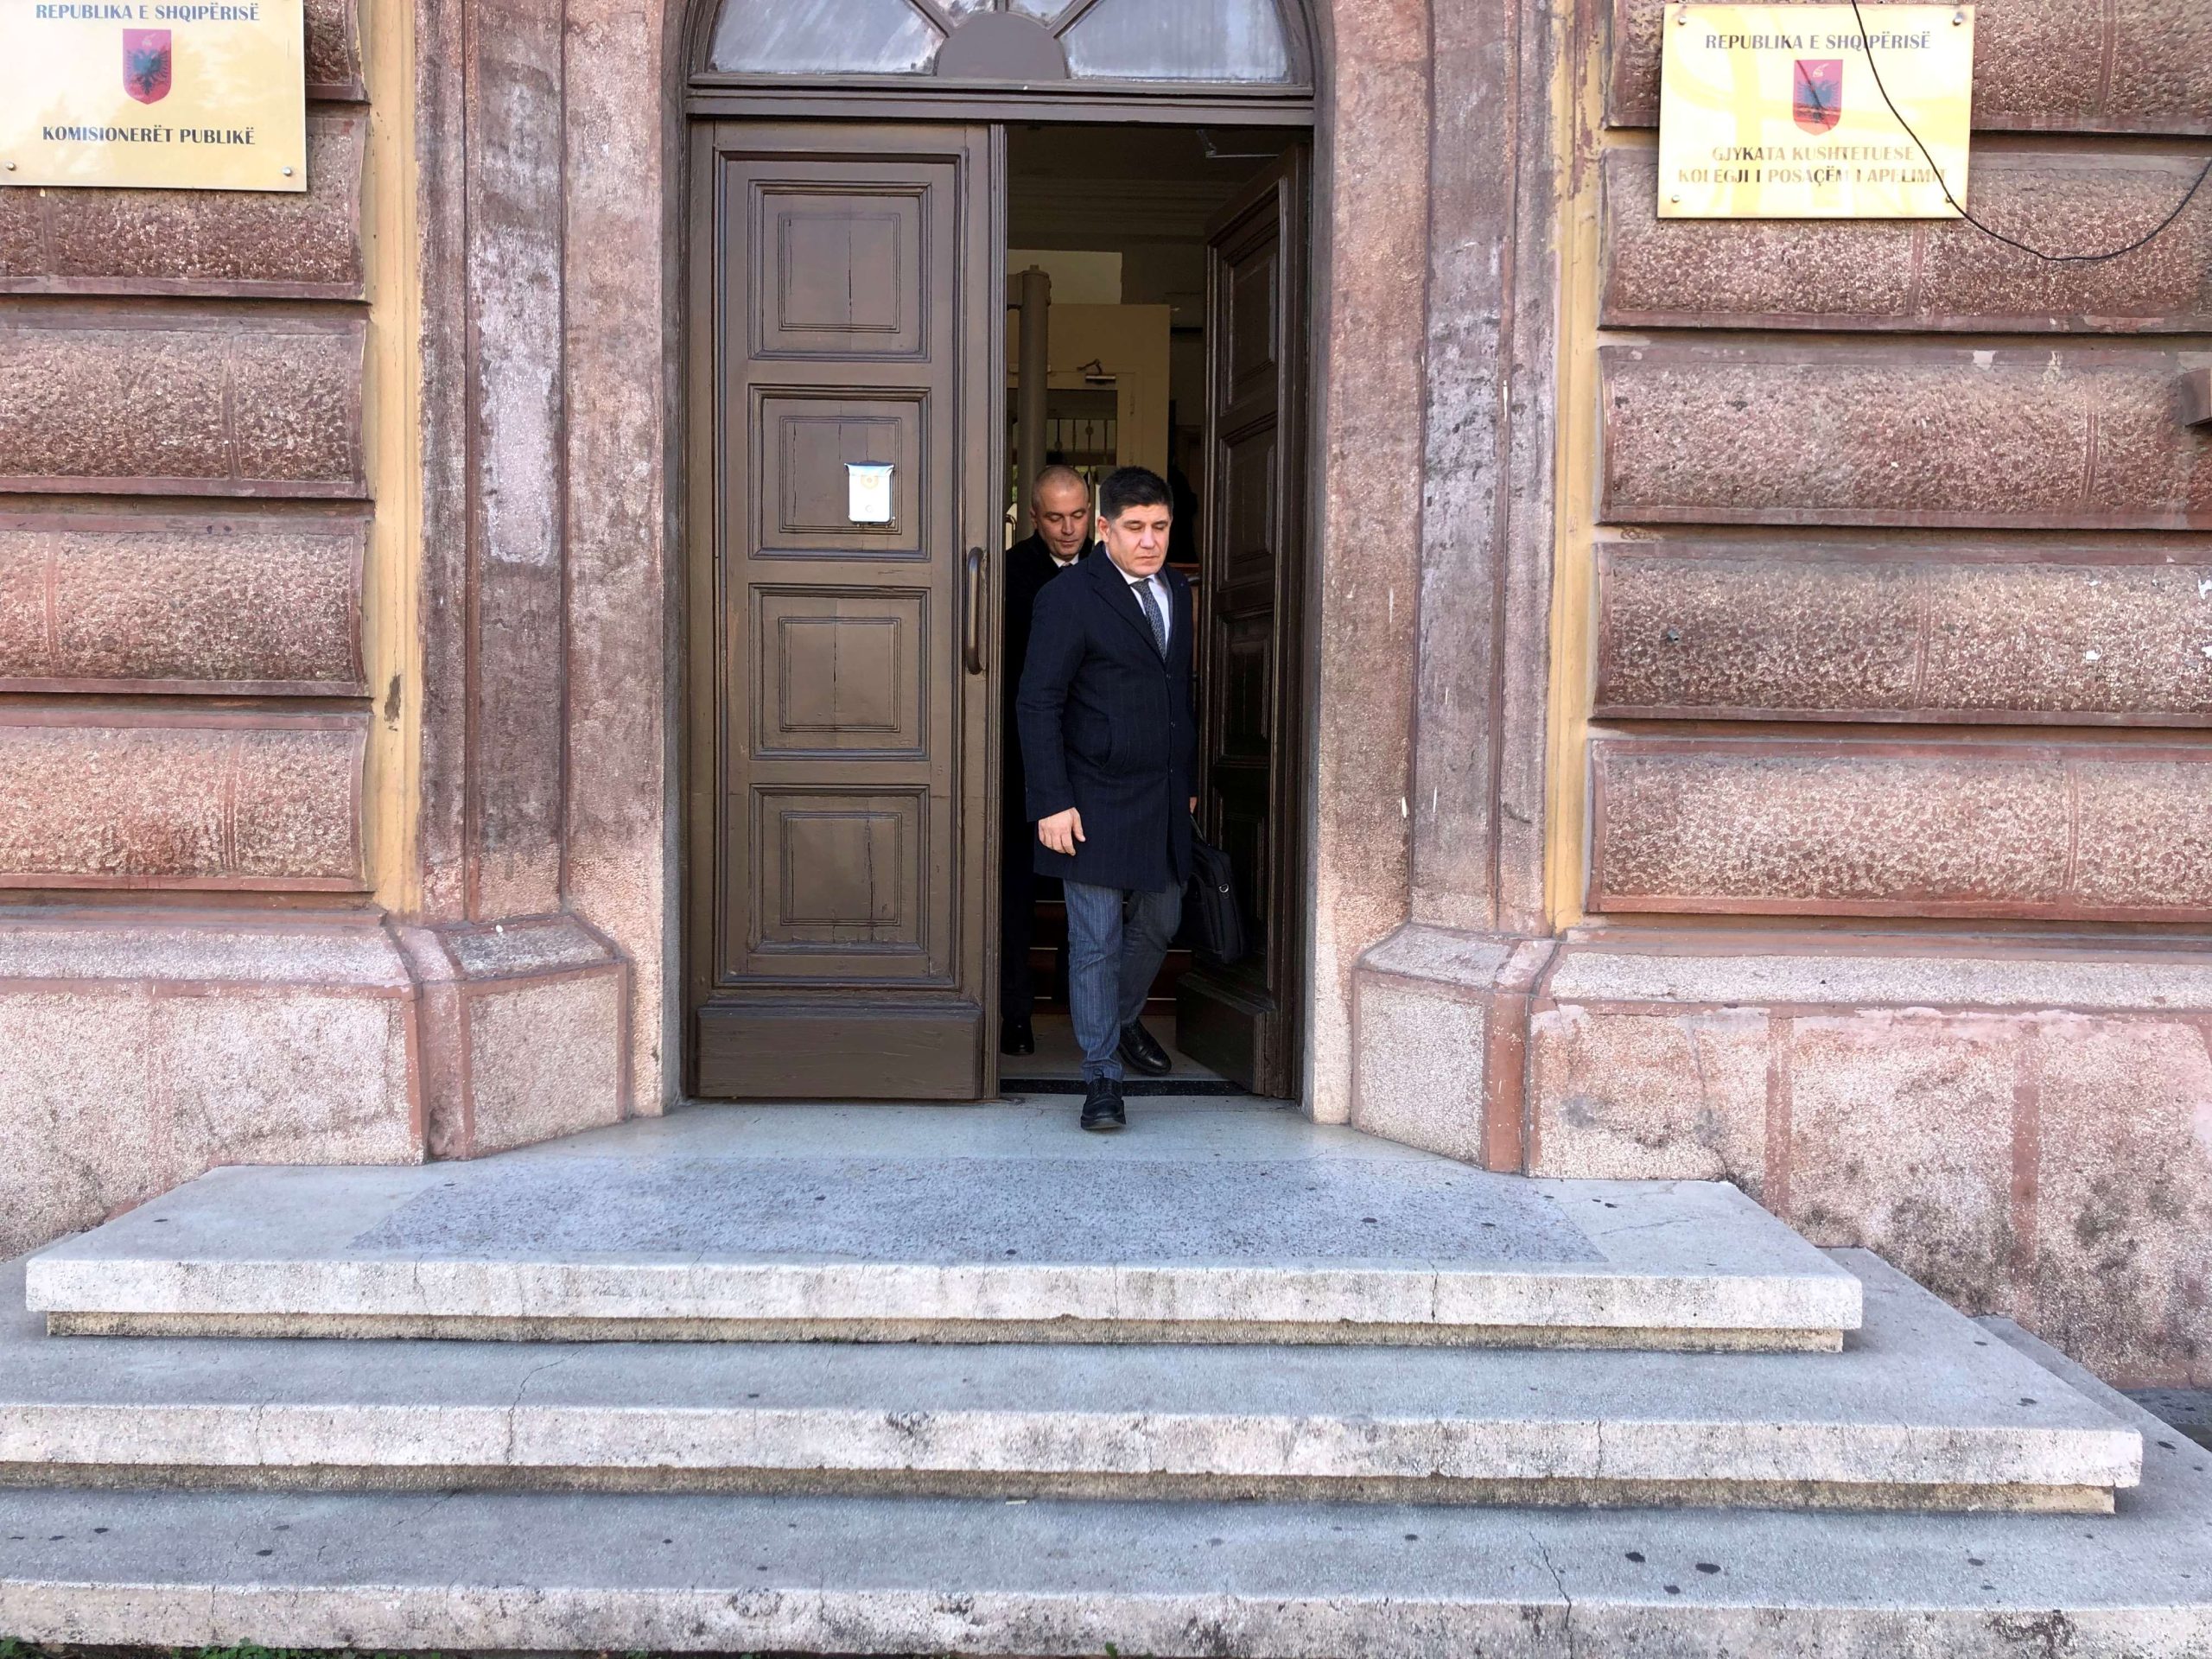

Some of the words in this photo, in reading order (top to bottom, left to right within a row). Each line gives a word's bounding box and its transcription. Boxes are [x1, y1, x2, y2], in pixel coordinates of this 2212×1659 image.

[35, 3, 133, 20] REPUBLIKA
[139, 5, 149, 20] E
[155, 3, 260, 22] SHQIPËRISË
[1706, 35, 1803, 49] REPUBLIKA
[1810, 35, 1820, 49] E
[42, 124, 173, 143] KOMISIONERËT
[180, 126, 256, 145] PUBLIKË
[1712, 147, 1785, 161] GJYKATA
[1792, 146, 1914, 161] KUSHTETUESE
